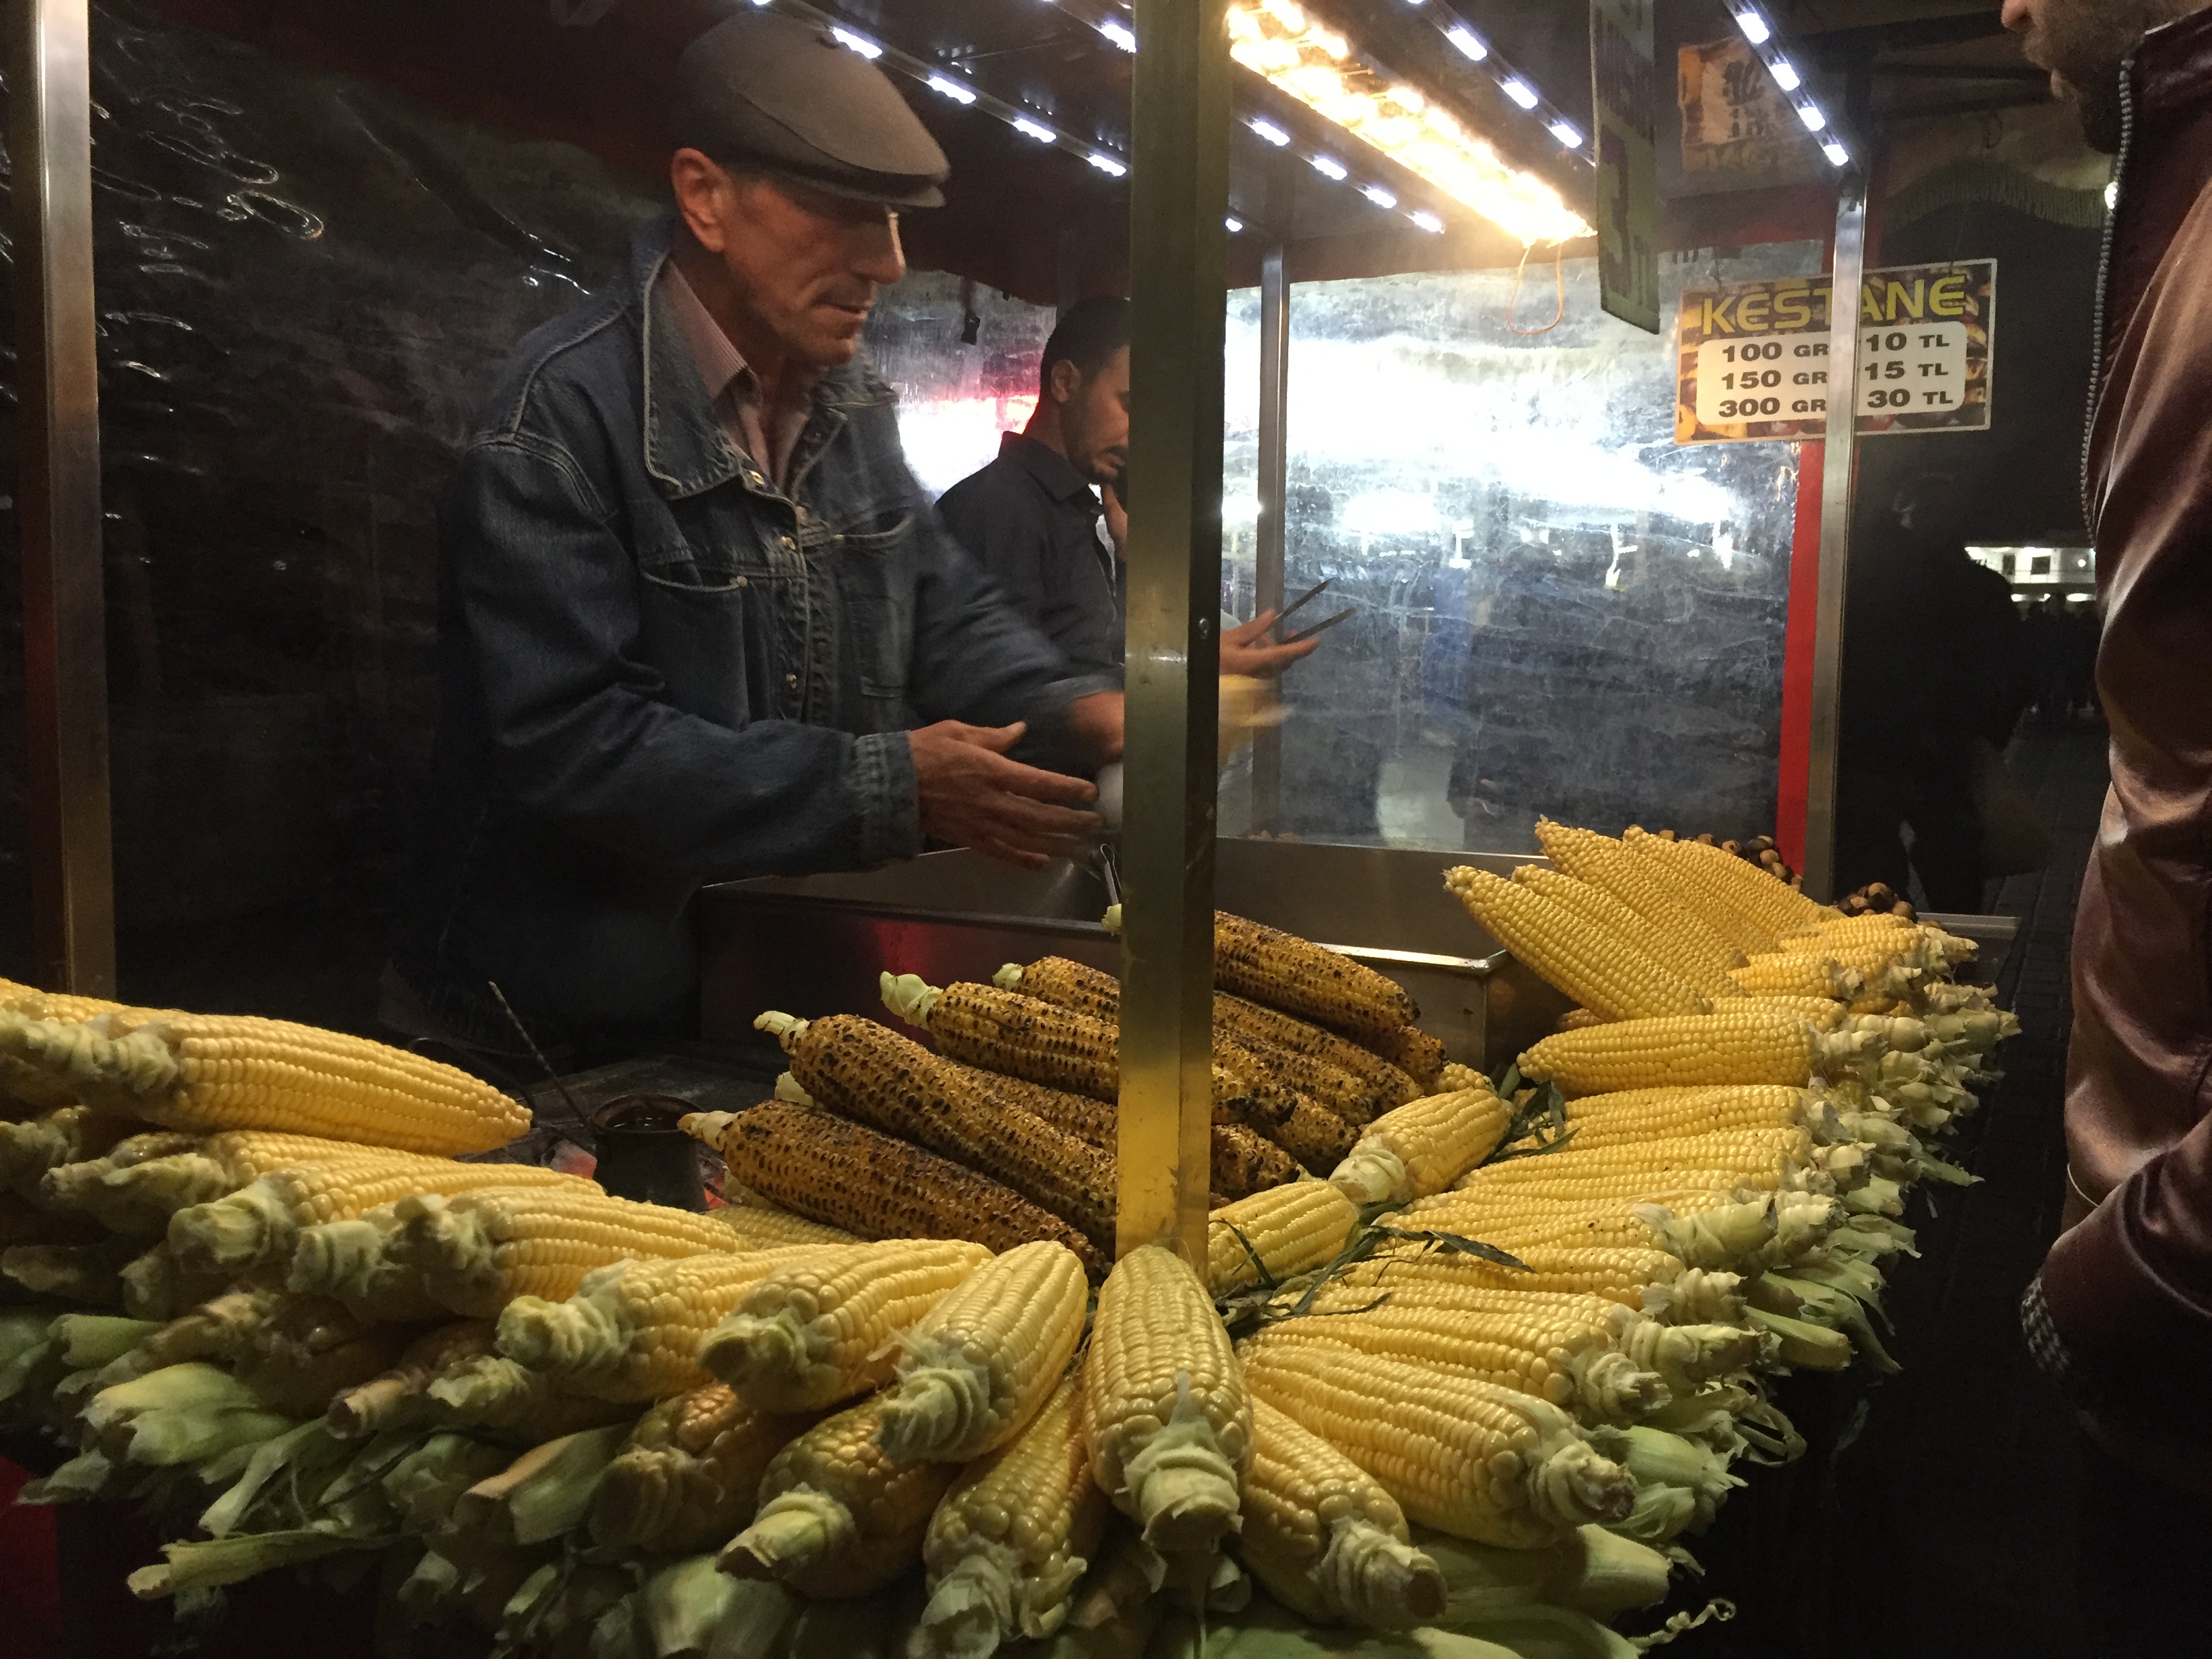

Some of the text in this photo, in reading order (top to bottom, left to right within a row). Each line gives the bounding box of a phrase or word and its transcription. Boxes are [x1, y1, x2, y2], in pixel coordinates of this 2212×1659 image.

[1702, 275, 1965, 335] KESTANE
[1722, 332, 1950, 363] 100 GR 10 TL
[1721, 361, 1948, 390] 150 GR 15 TL
[1718, 388, 1953, 418] 300 GR 30 TL
